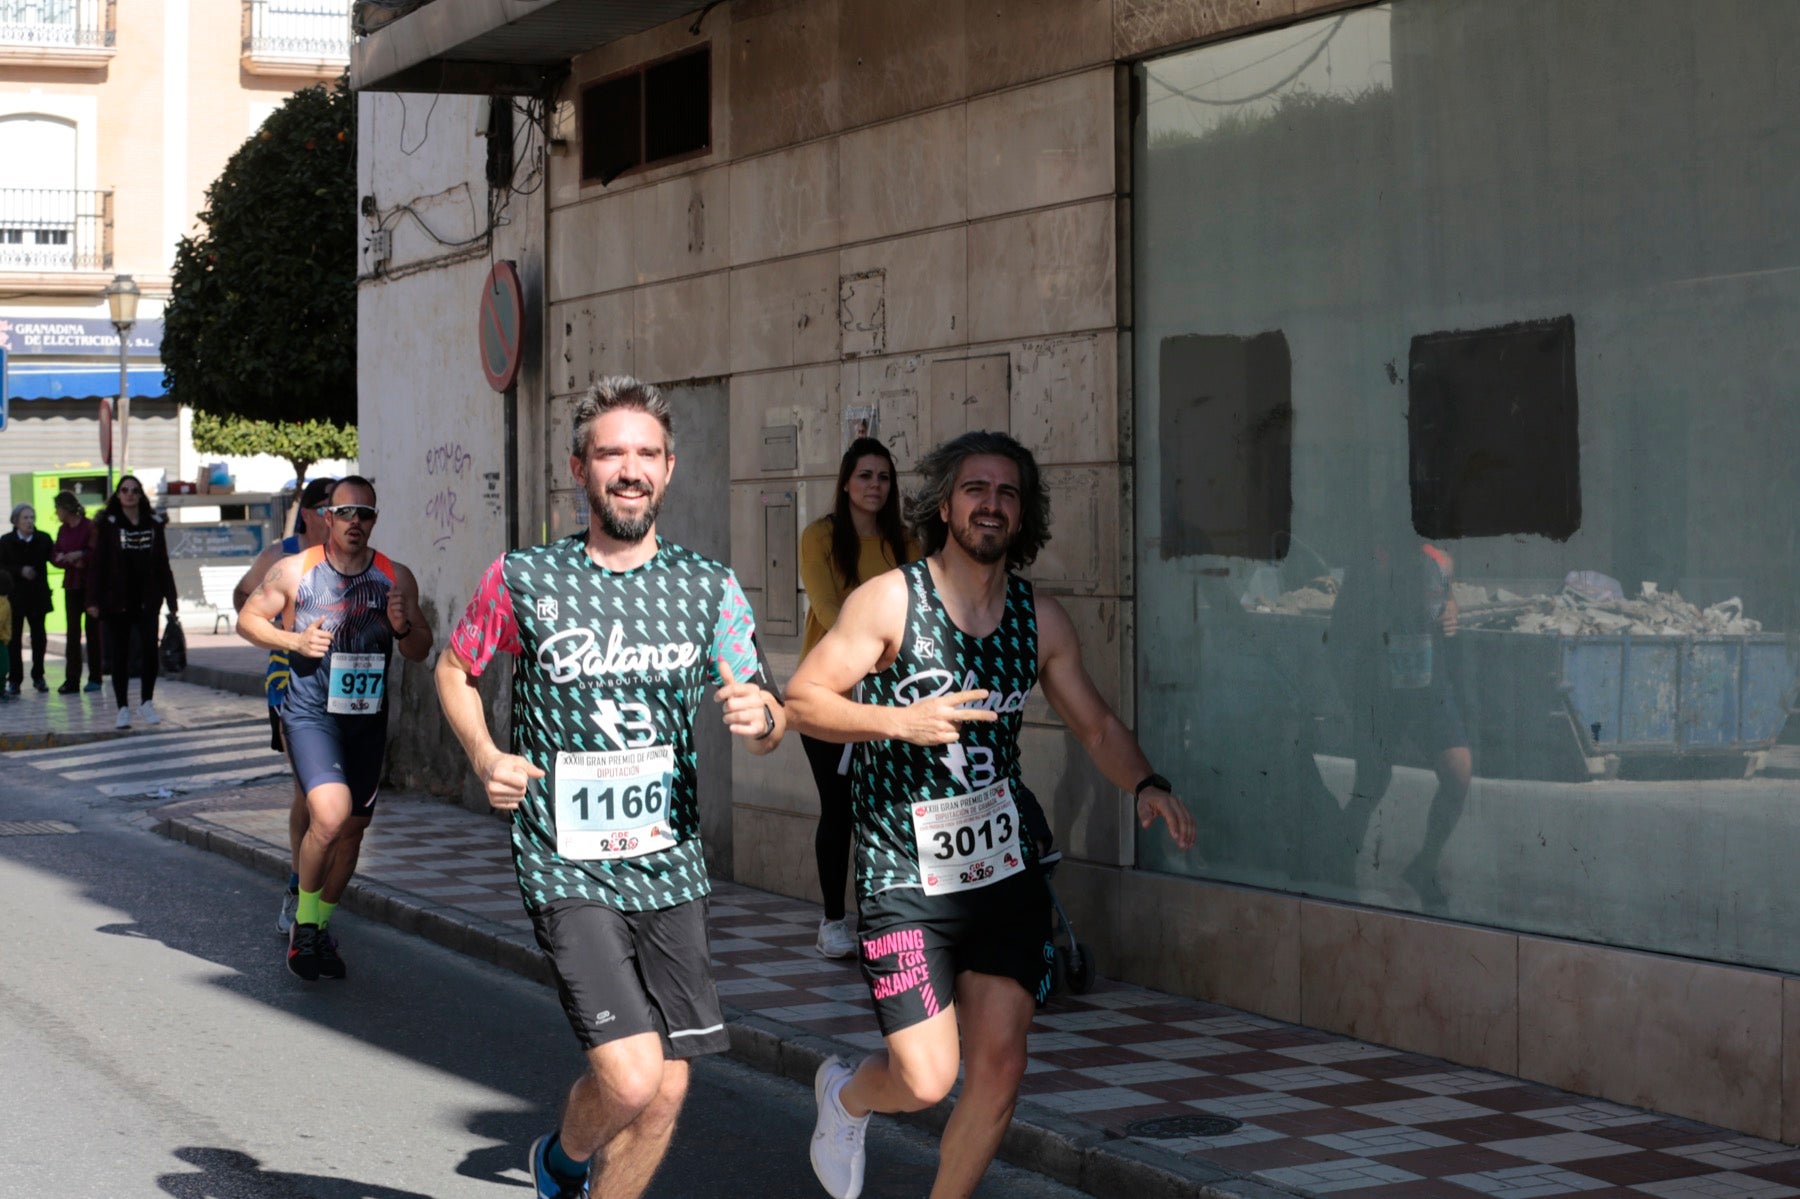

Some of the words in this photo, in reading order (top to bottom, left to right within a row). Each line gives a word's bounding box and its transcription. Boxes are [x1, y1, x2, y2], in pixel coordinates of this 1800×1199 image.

[15, 323, 85, 335] GRANADINA
[24, 335, 42, 345] DE
[537, 623, 699, 684] Balance
[341, 673, 382, 695] 937
[579, 681, 604, 690] GYM
[586, 756, 607, 767] GRAN
[608, 754, 636, 766] PREMIO
[636, 753, 645, 763] DE
[572, 780, 662, 820] 1166
[940, 801, 959, 812] GRAN
[960, 795, 983, 808] PREMIO
[983, 792, 990, 800] DE
[932, 812, 1013, 860] 3013
[863, 928, 925, 960] TRAINING
[873, 963, 929, 1000] BALANCE
